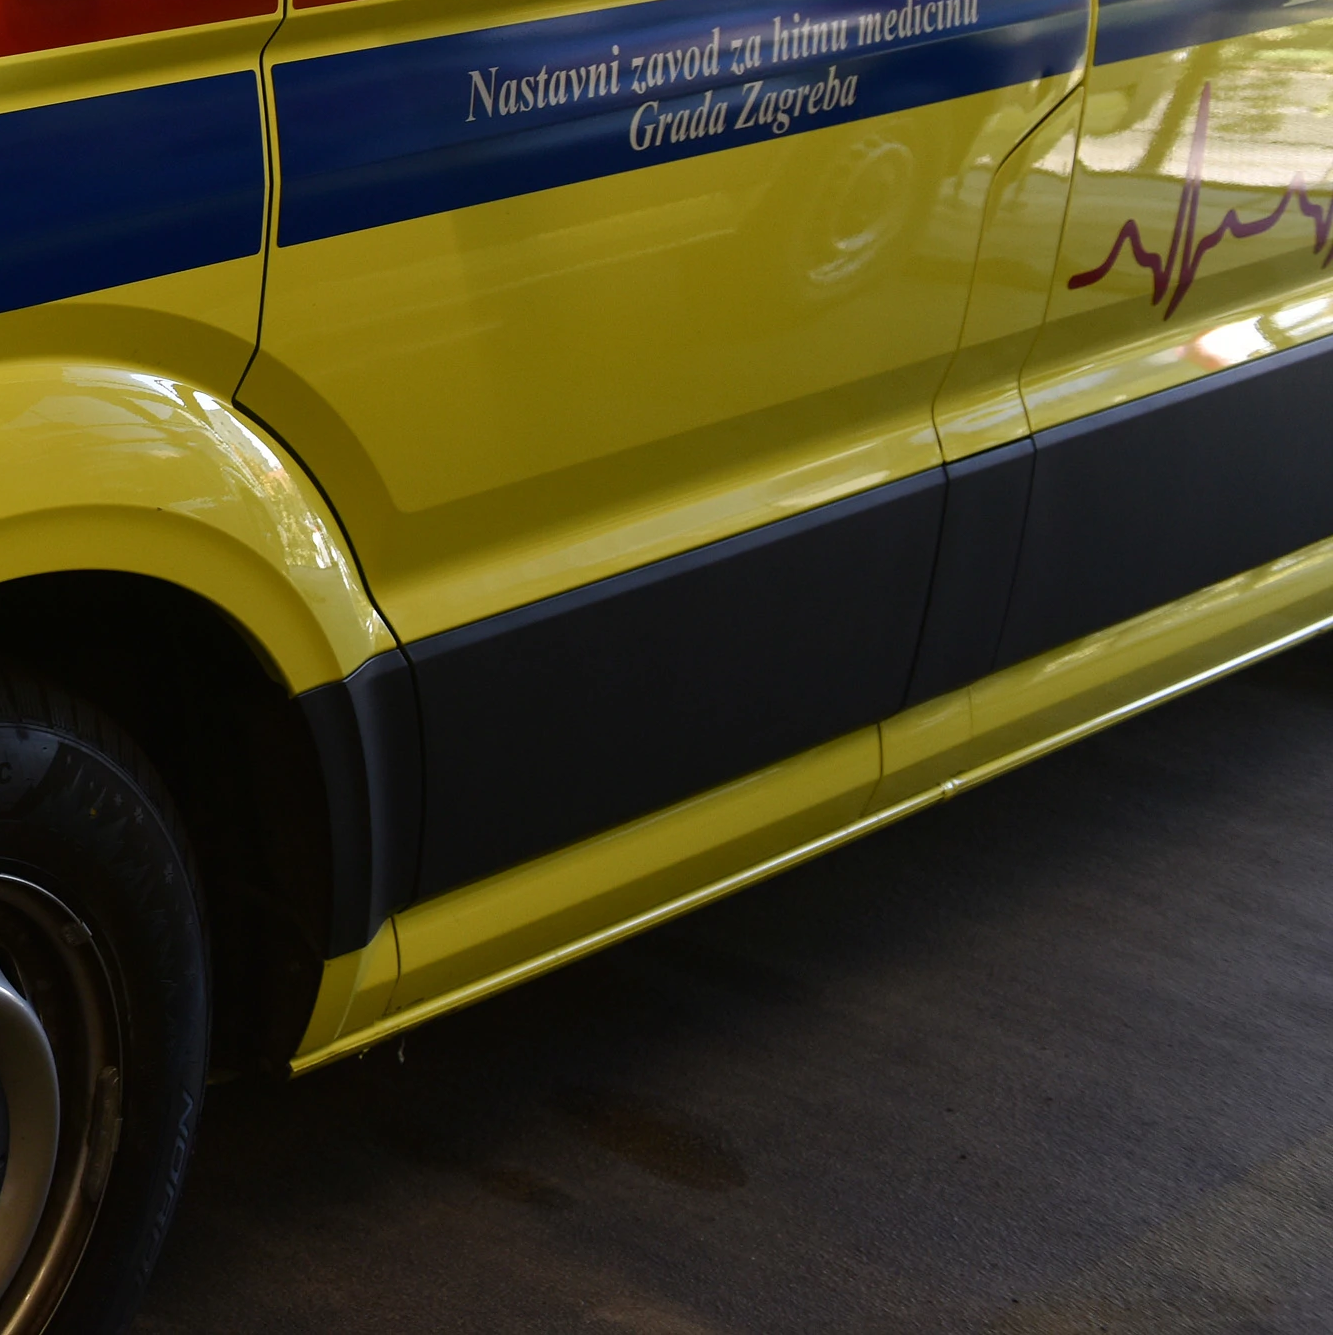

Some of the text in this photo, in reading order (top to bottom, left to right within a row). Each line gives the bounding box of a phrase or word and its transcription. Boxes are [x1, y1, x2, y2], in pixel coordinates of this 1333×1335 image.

[465, 44, 621, 123] Nastavni
[630, 26, 720, 93] zavod
[730, 31, 762, 75] za
[771, 11, 849, 63] hitnu
[628, 65, 858, 152] Grada Zagreba
